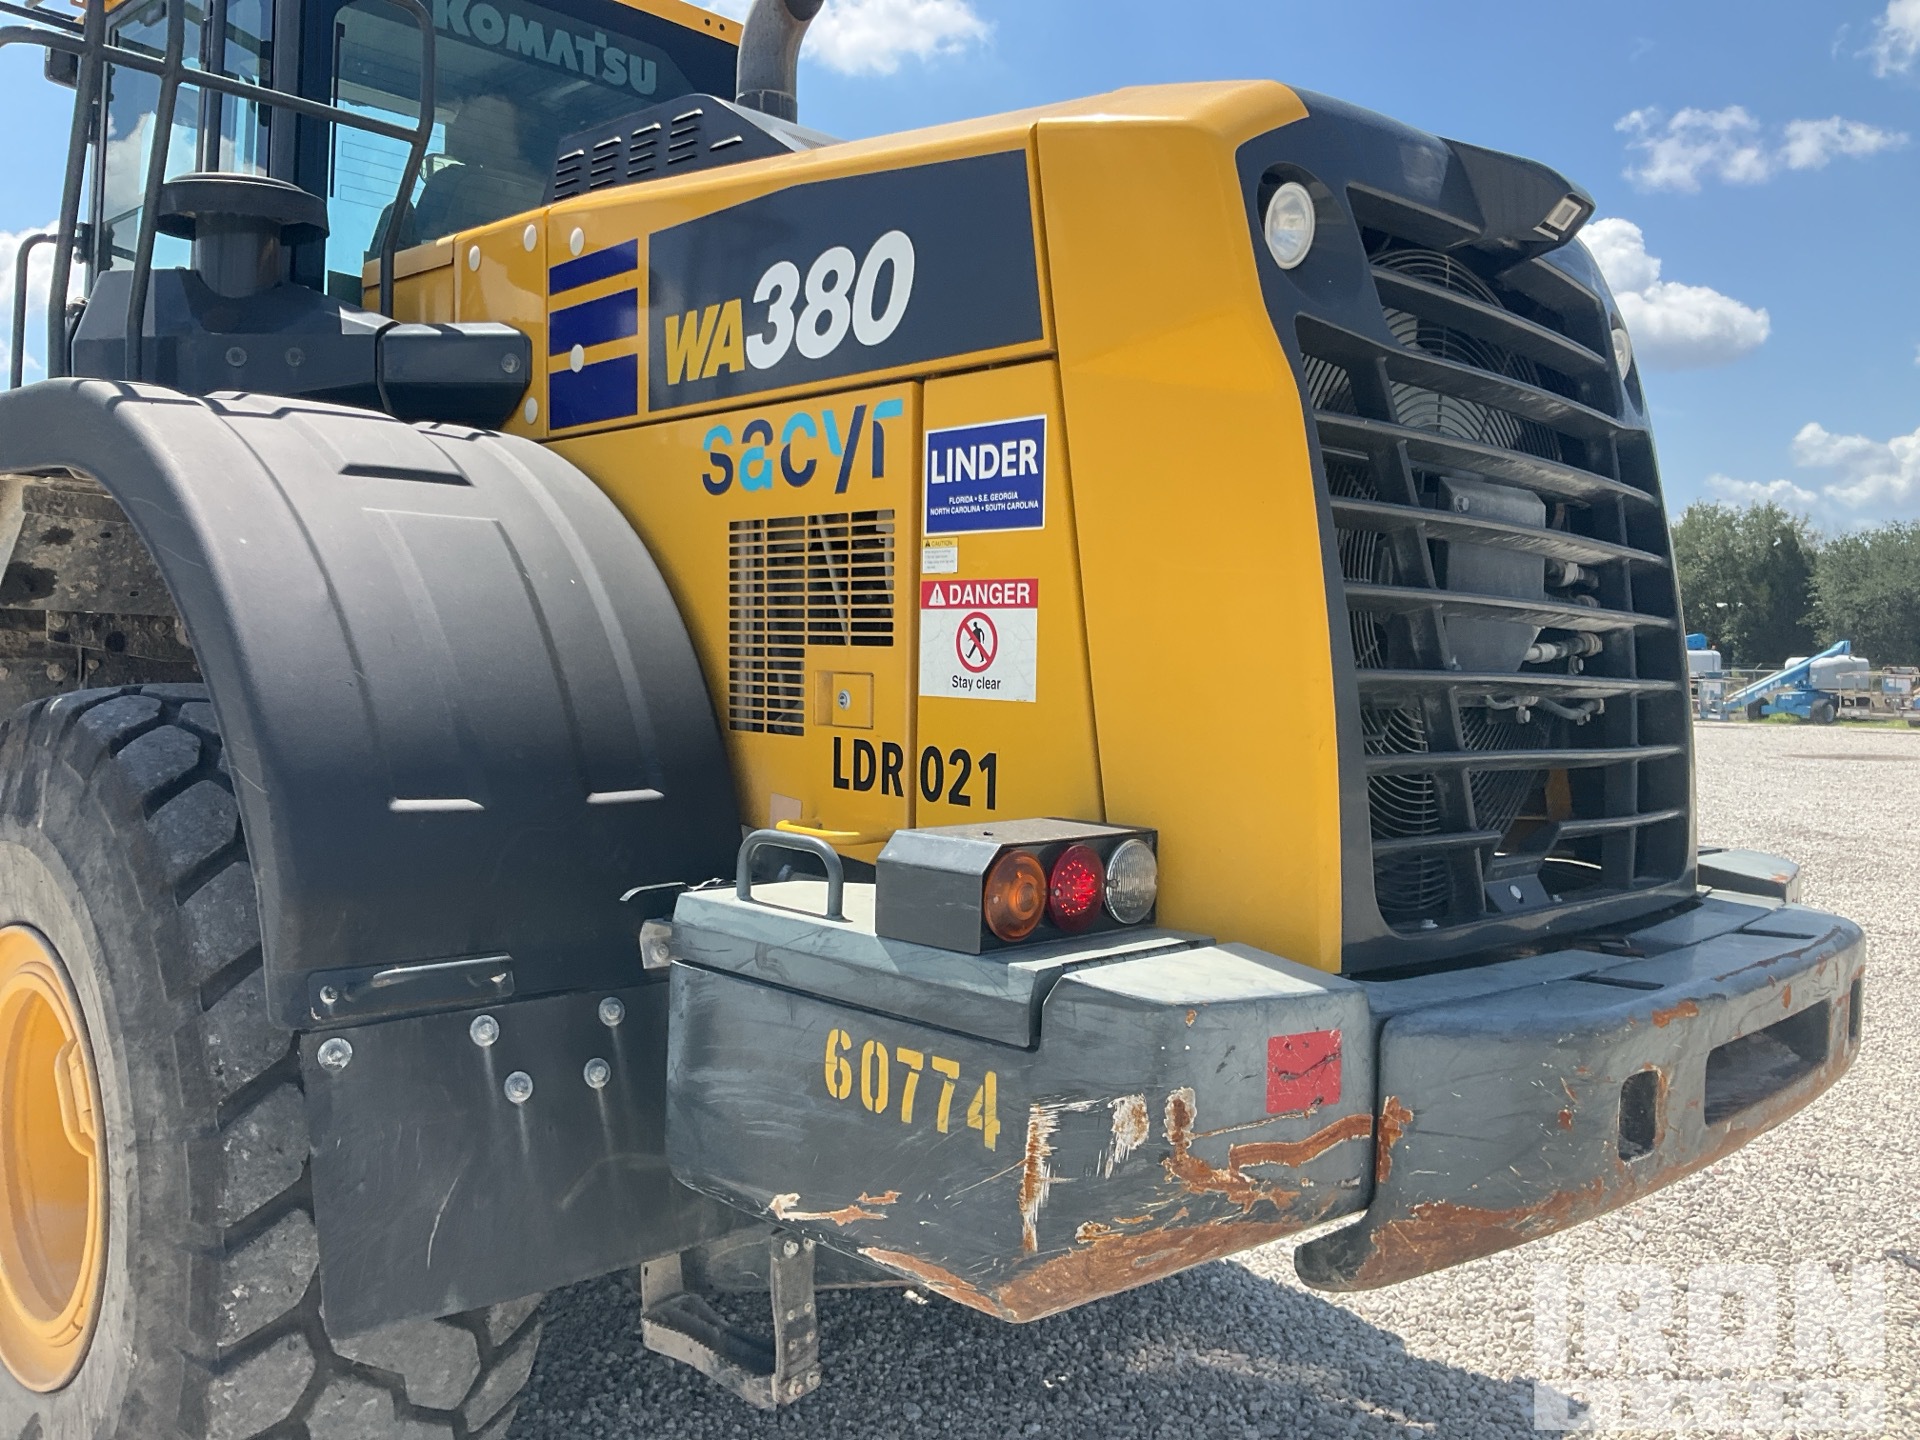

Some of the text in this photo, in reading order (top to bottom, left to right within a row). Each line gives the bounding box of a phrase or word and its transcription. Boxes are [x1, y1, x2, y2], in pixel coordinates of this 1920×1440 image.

[432, 0, 657, 95] KOMATSU
[664, 229, 916, 386] WA380
[702, 398, 904, 496] sacyr
[930, 438, 1039, 485] LINDER
[930, 500, 1039, 516] NORTH CAROLINA SOUTH CAROLINA
[948, 491, 1018, 505] FLORIDA S.E. GEORGIA
[949, 582, 1031, 605] DANGER
[951, 675, 1002, 693] Stay clear
[832, 736, 998, 810] LDR 021
[824, 1028, 1001, 1152] 60774
